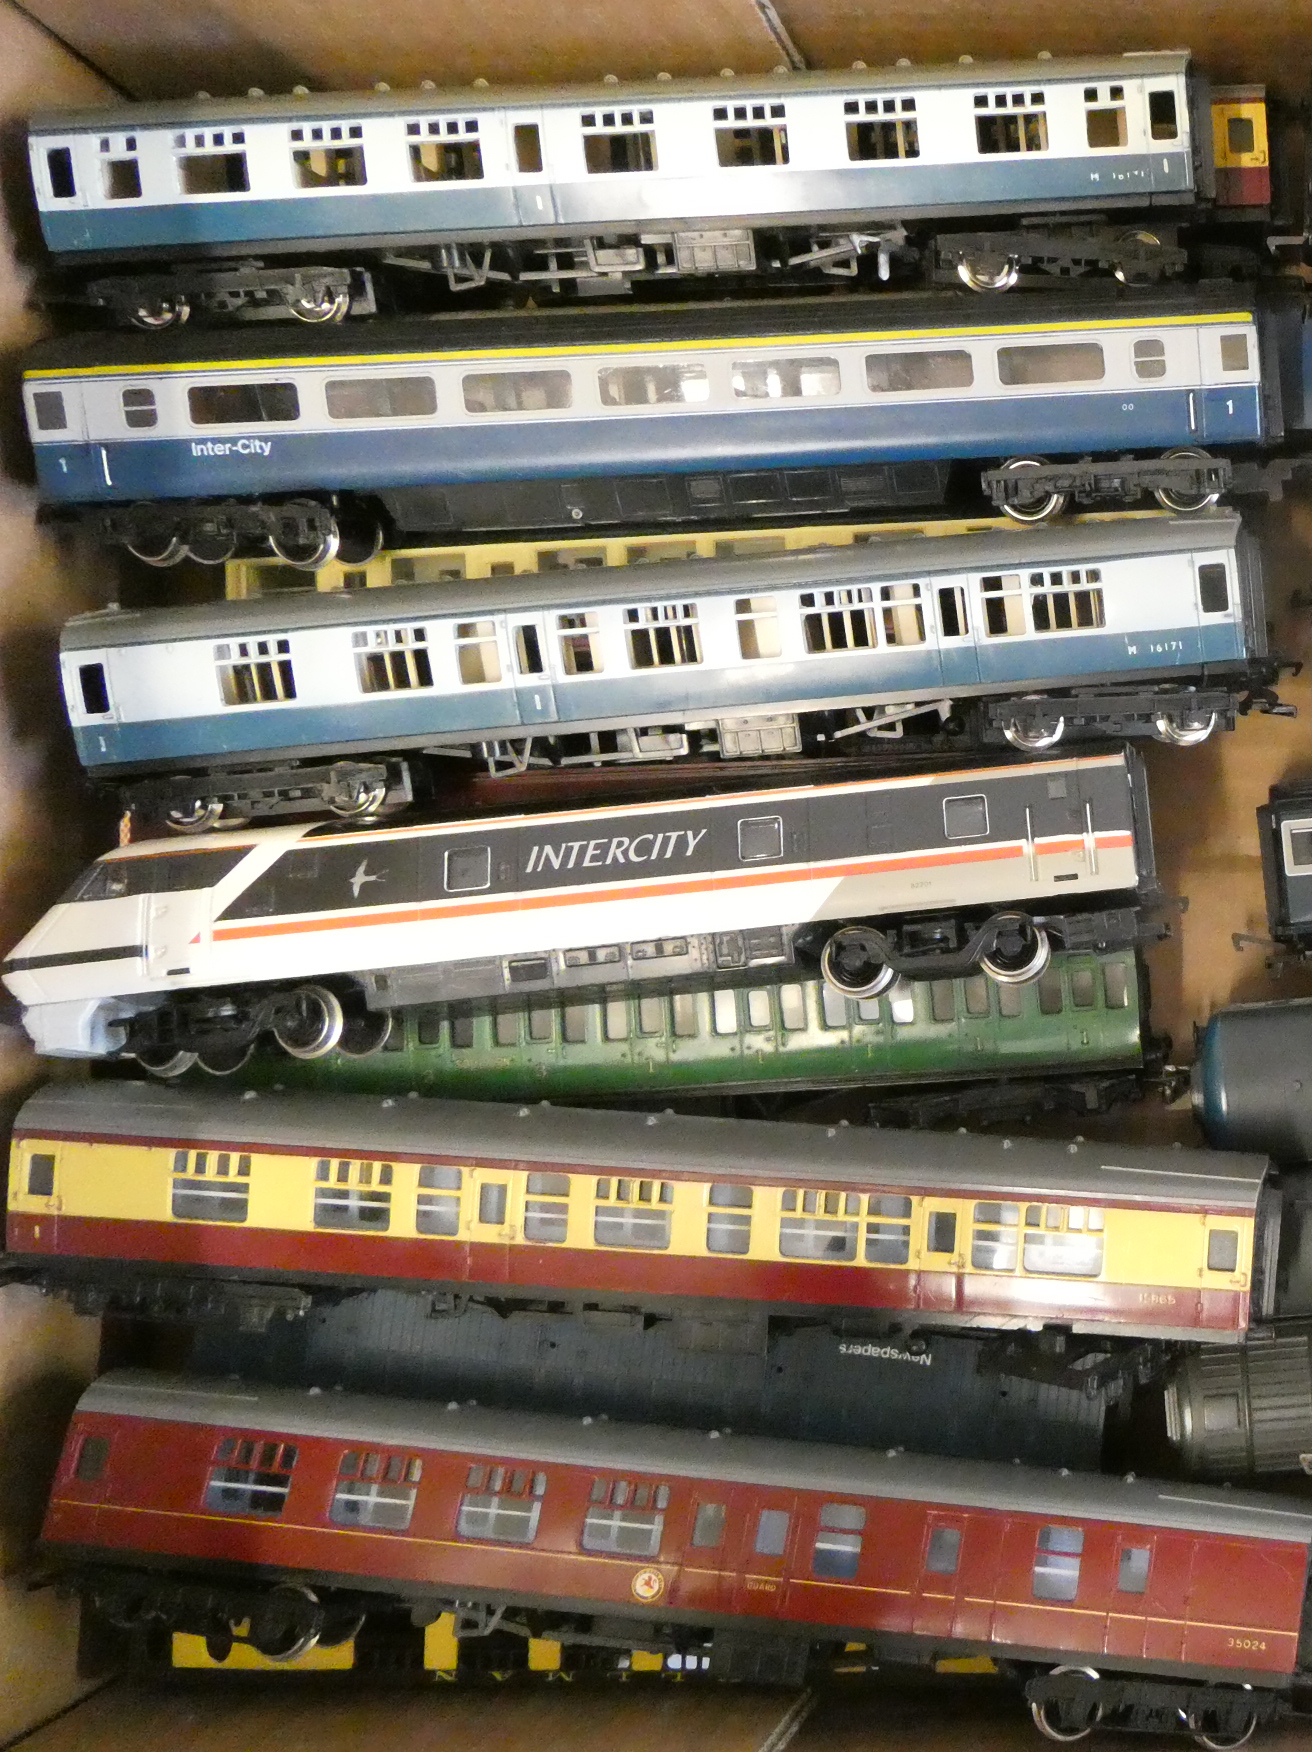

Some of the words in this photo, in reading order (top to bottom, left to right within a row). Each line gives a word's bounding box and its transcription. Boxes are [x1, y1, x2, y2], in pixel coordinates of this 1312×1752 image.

[1226, 399, 1233, 415] 1
[191, 439, 272, 457] Inter-City
[1150, 640, 1183, 653] 16171
[525, 828, 707, 873] INTERCITY
[1227, 1637, 1266, 1651] 35024
